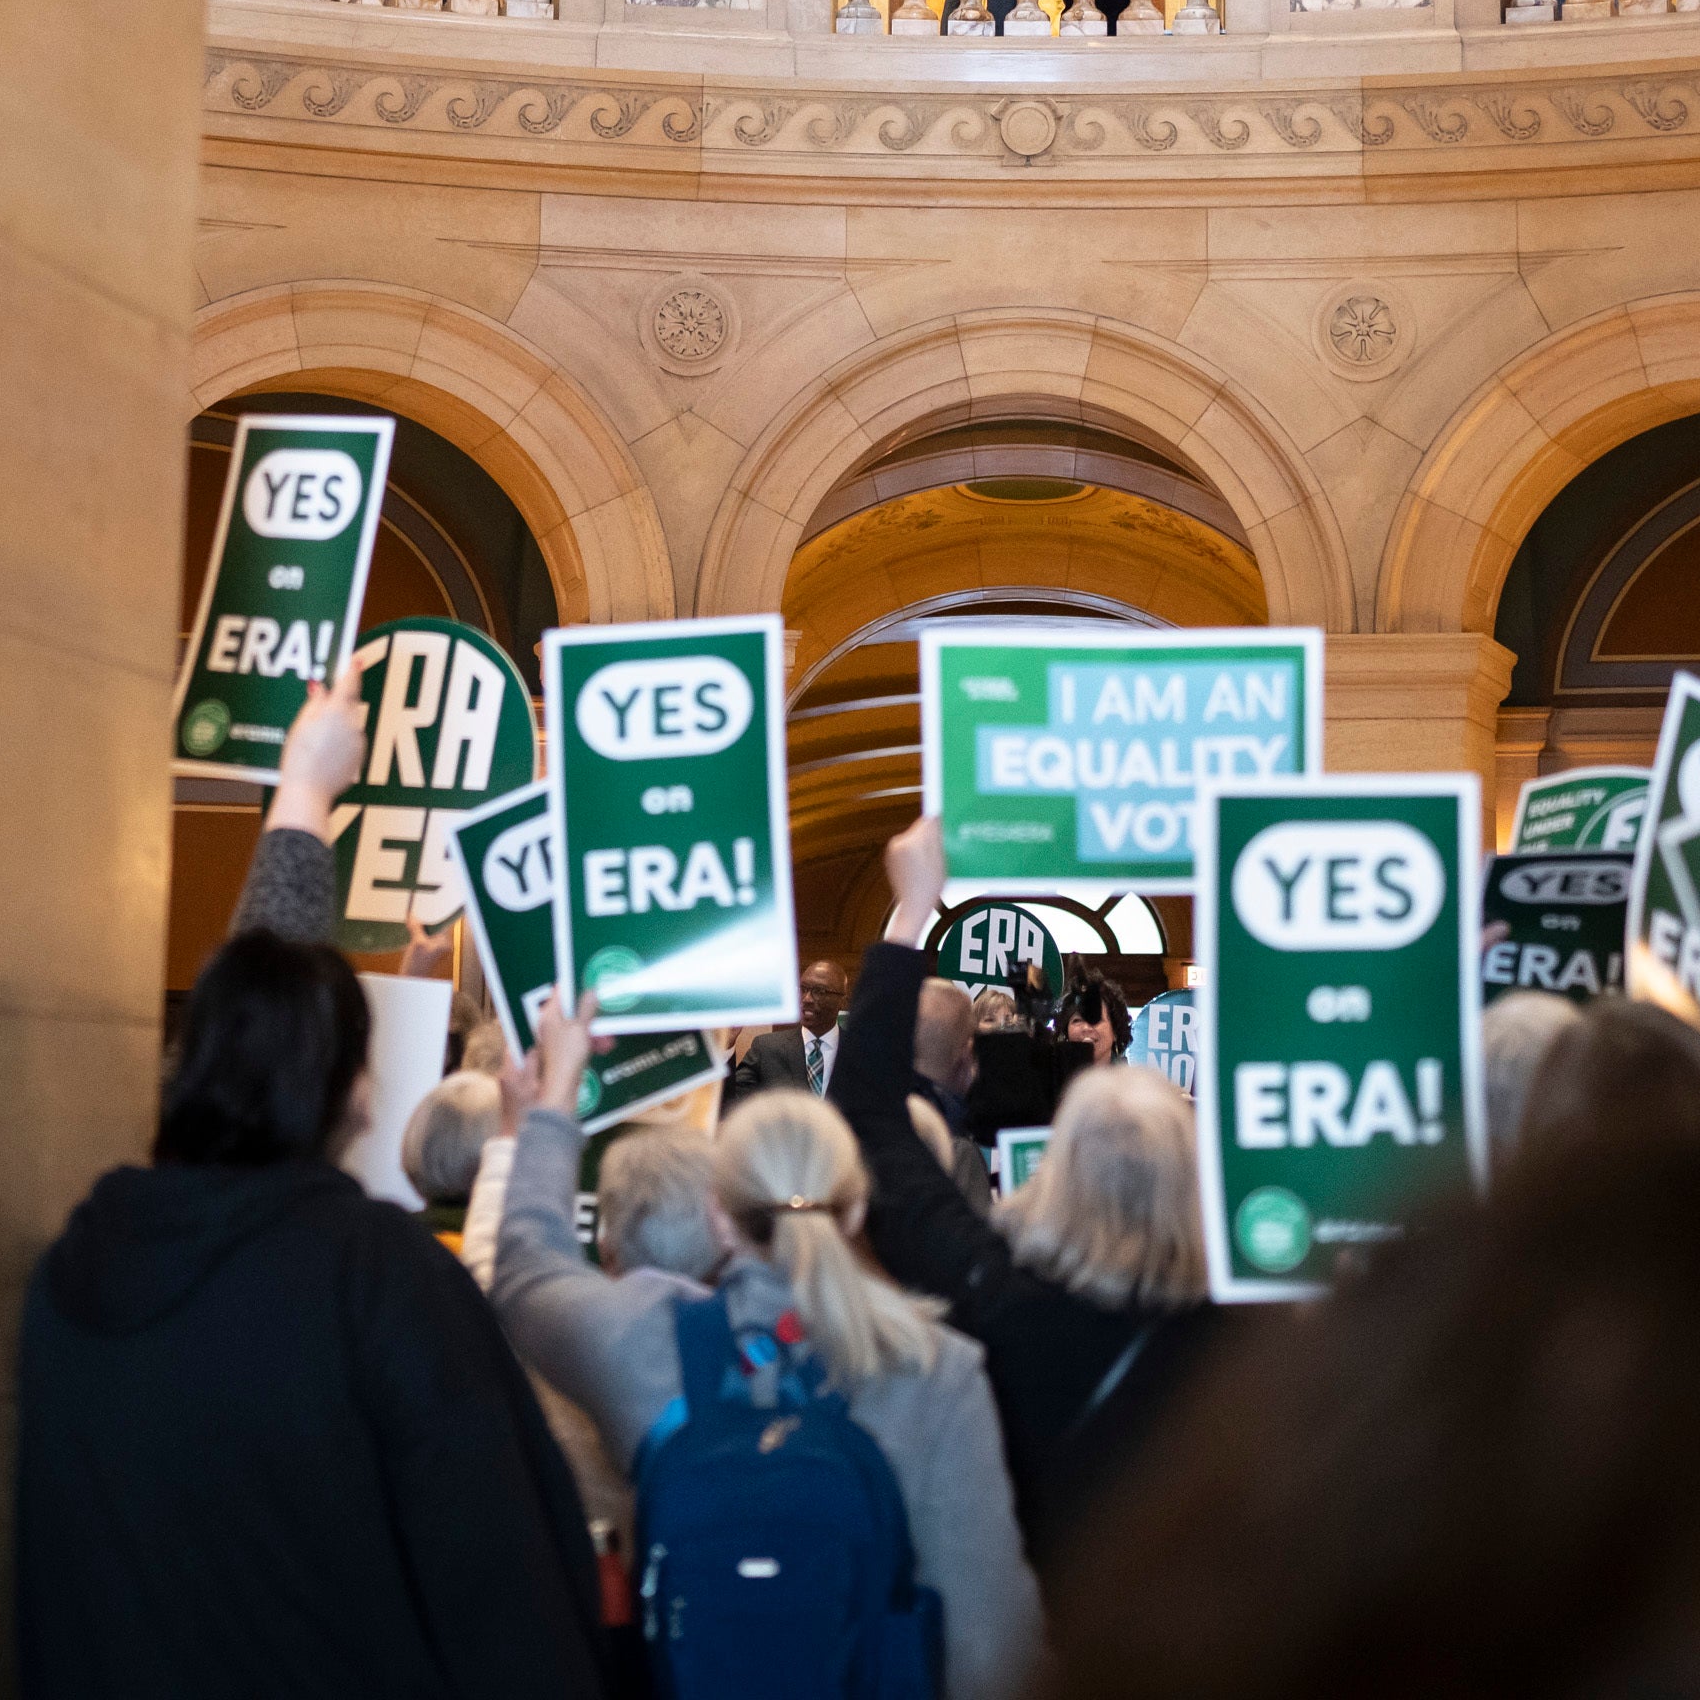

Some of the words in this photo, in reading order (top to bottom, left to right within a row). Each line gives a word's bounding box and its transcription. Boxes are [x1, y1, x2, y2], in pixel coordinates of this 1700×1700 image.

[263, 471, 345, 522] YES
[268, 565, 305, 590] on
[206, 613, 335, 681] ERA!
[601, 682, 728, 739] YES
[1060, 673, 1077, 725] I
[1092, 673, 1186, 725] AM
[1203, 672, 1286, 723] AN
[990, 733, 1287, 791] EQUALITY
[640, 785, 694, 815] on
[1090, 801, 1197, 853] VOT
[327, 804, 471, 927] ES
[582, 836, 757, 918] ERA!
[1264, 856, 1413, 923] YES
[1521, 871, 1624, 896] YES
[959, 908, 1044, 977] ERA
[1540, 913, 1581, 931] on
[1484, 940, 1623, 998] ERA!
[1148, 1004, 1199, 1052] ER
[1306, 984, 1372, 1023] on
[1146, 1051, 1195, 1093] NO
[1234, 1056, 1444, 1150] ERA!
